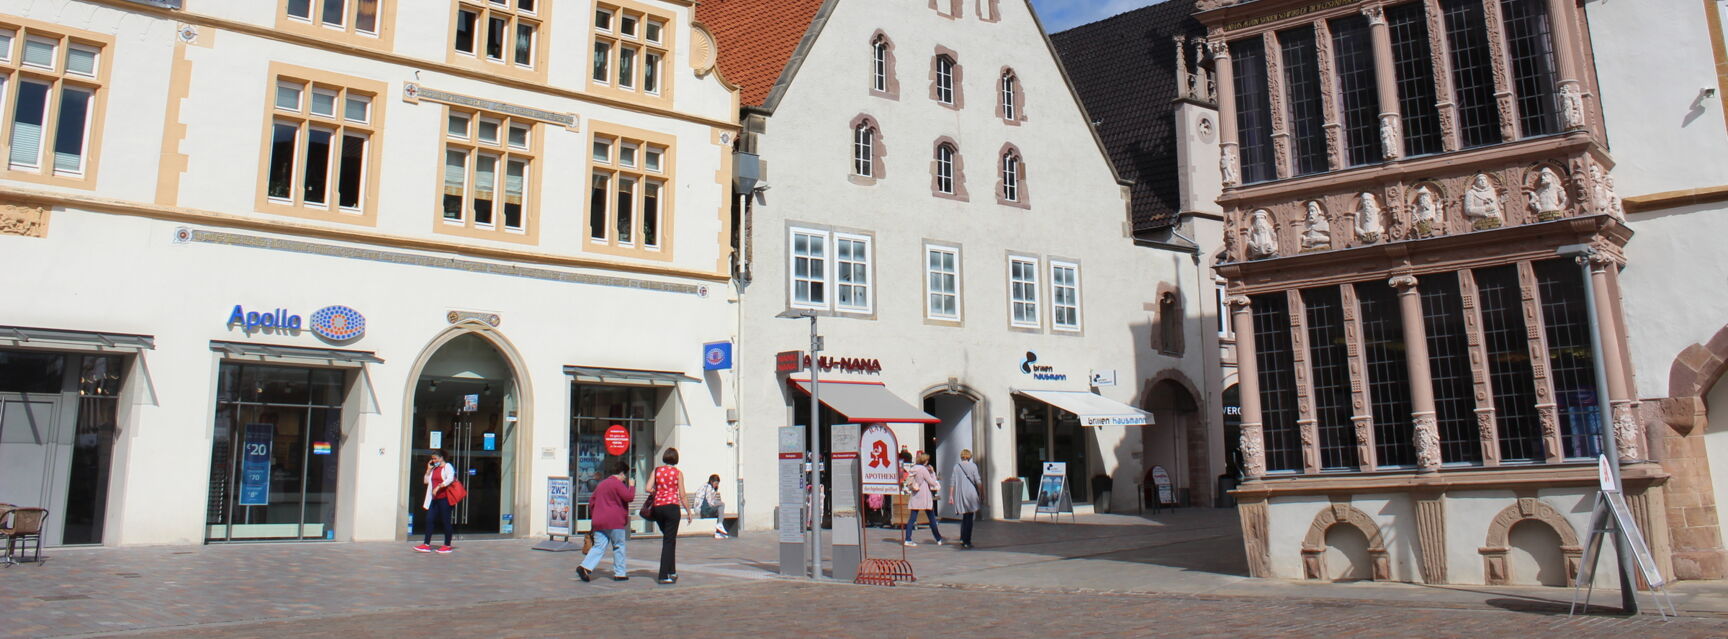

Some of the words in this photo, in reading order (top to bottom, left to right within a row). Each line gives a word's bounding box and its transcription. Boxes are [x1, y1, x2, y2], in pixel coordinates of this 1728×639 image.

[227, 304, 302, 330] Apollo
[804, 355, 882, 371] ANU-NANA
[1033, 364, 1053, 372] brillen
[1033, 373, 1067, 381] hausmann
[1088, 416, 1110, 425] brillen
[1112, 416, 1149, 425] hausmann
[247, 443, 267, 456] €20
